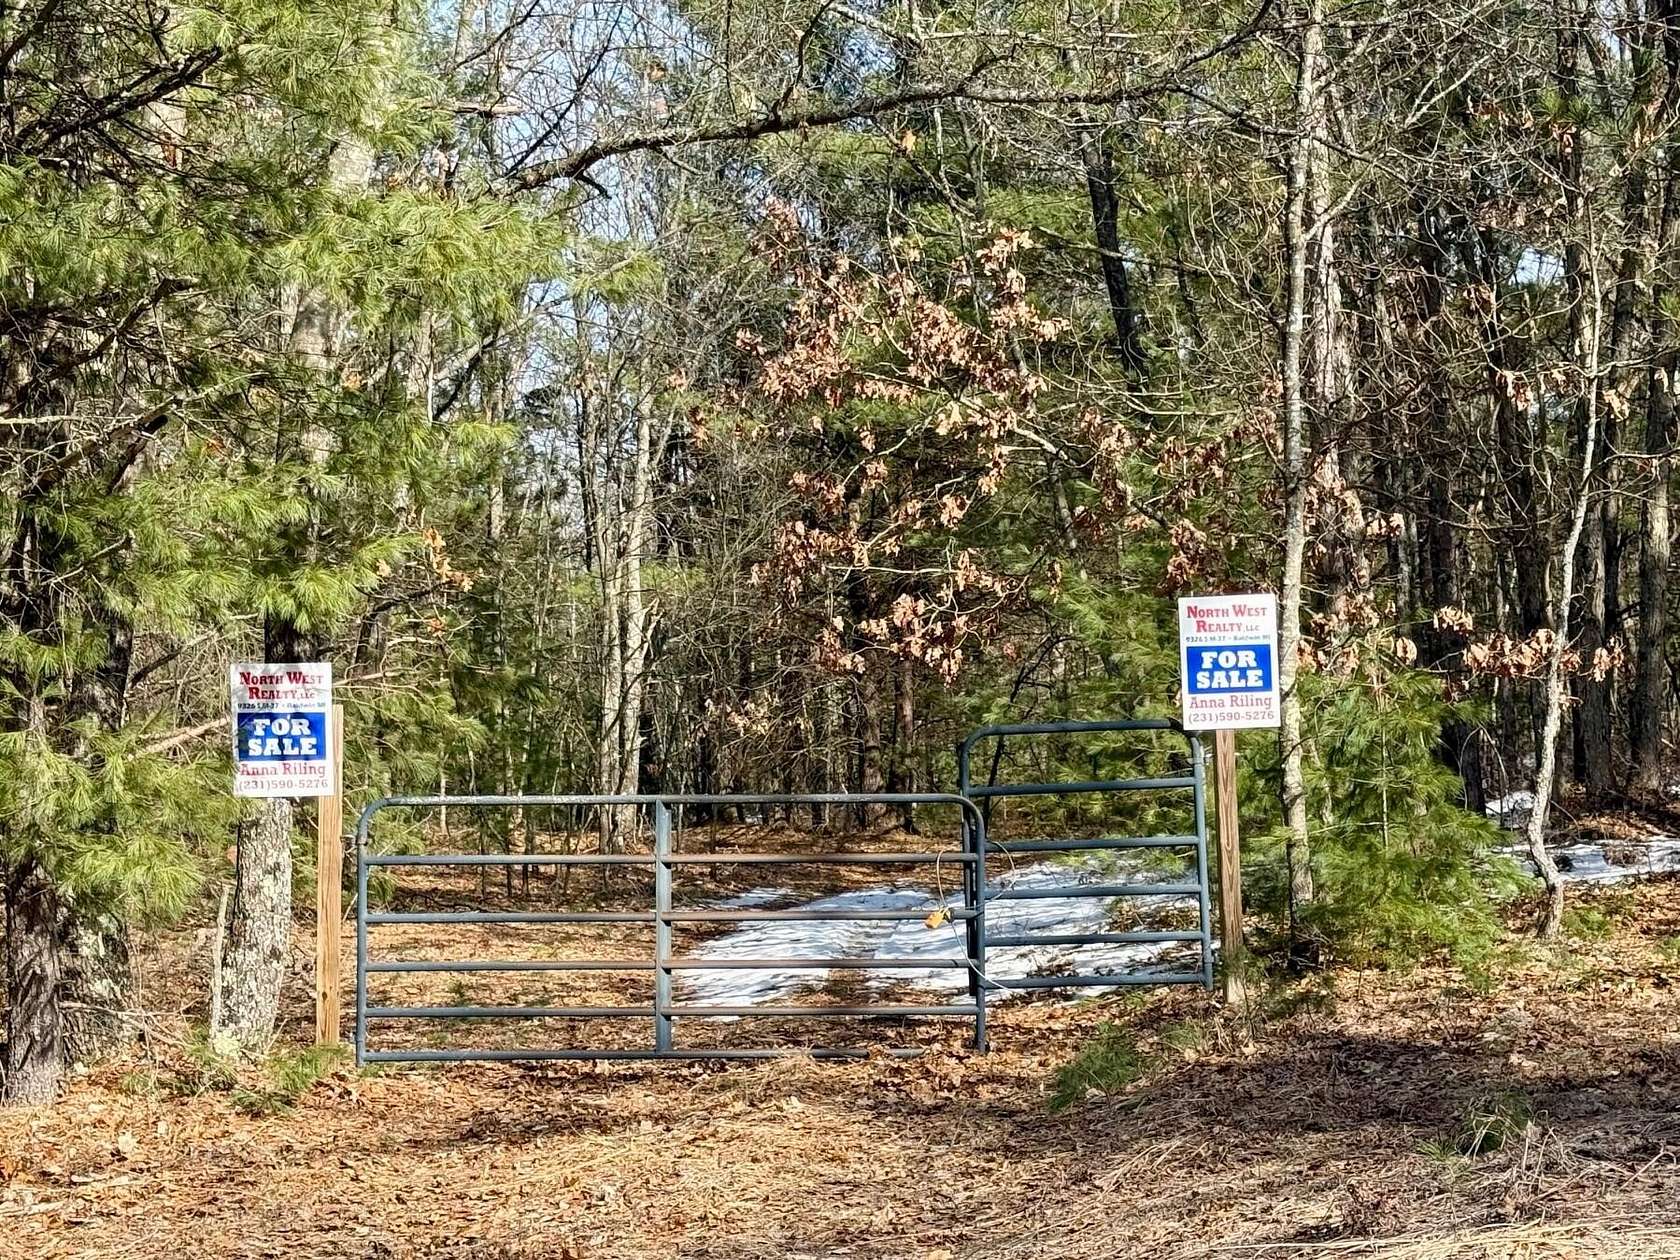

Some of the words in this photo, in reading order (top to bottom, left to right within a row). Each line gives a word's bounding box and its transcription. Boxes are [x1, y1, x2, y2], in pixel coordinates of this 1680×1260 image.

[1187, 605, 1230, 619] NORTH
[1232, 604, 1268, 618] WEST
[1201, 650, 1258, 669] FOR
[239, 671, 285, 686] NORTH
[286, 671, 324, 685] WEST
[1196, 669, 1264, 689] SALE
[1189, 696, 1226, 709] Anna
[1230, 694, 1273, 710] Riling
[1188, 711, 1275, 725] (231)590-5276
[253, 718, 311, 737] FOR
[248, 738, 318, 757] SALE
[239, 763, 278, 776] Anna
[282, 762, 326, 779] Riling
[239, 779, 329, 793] (231)590-5276
